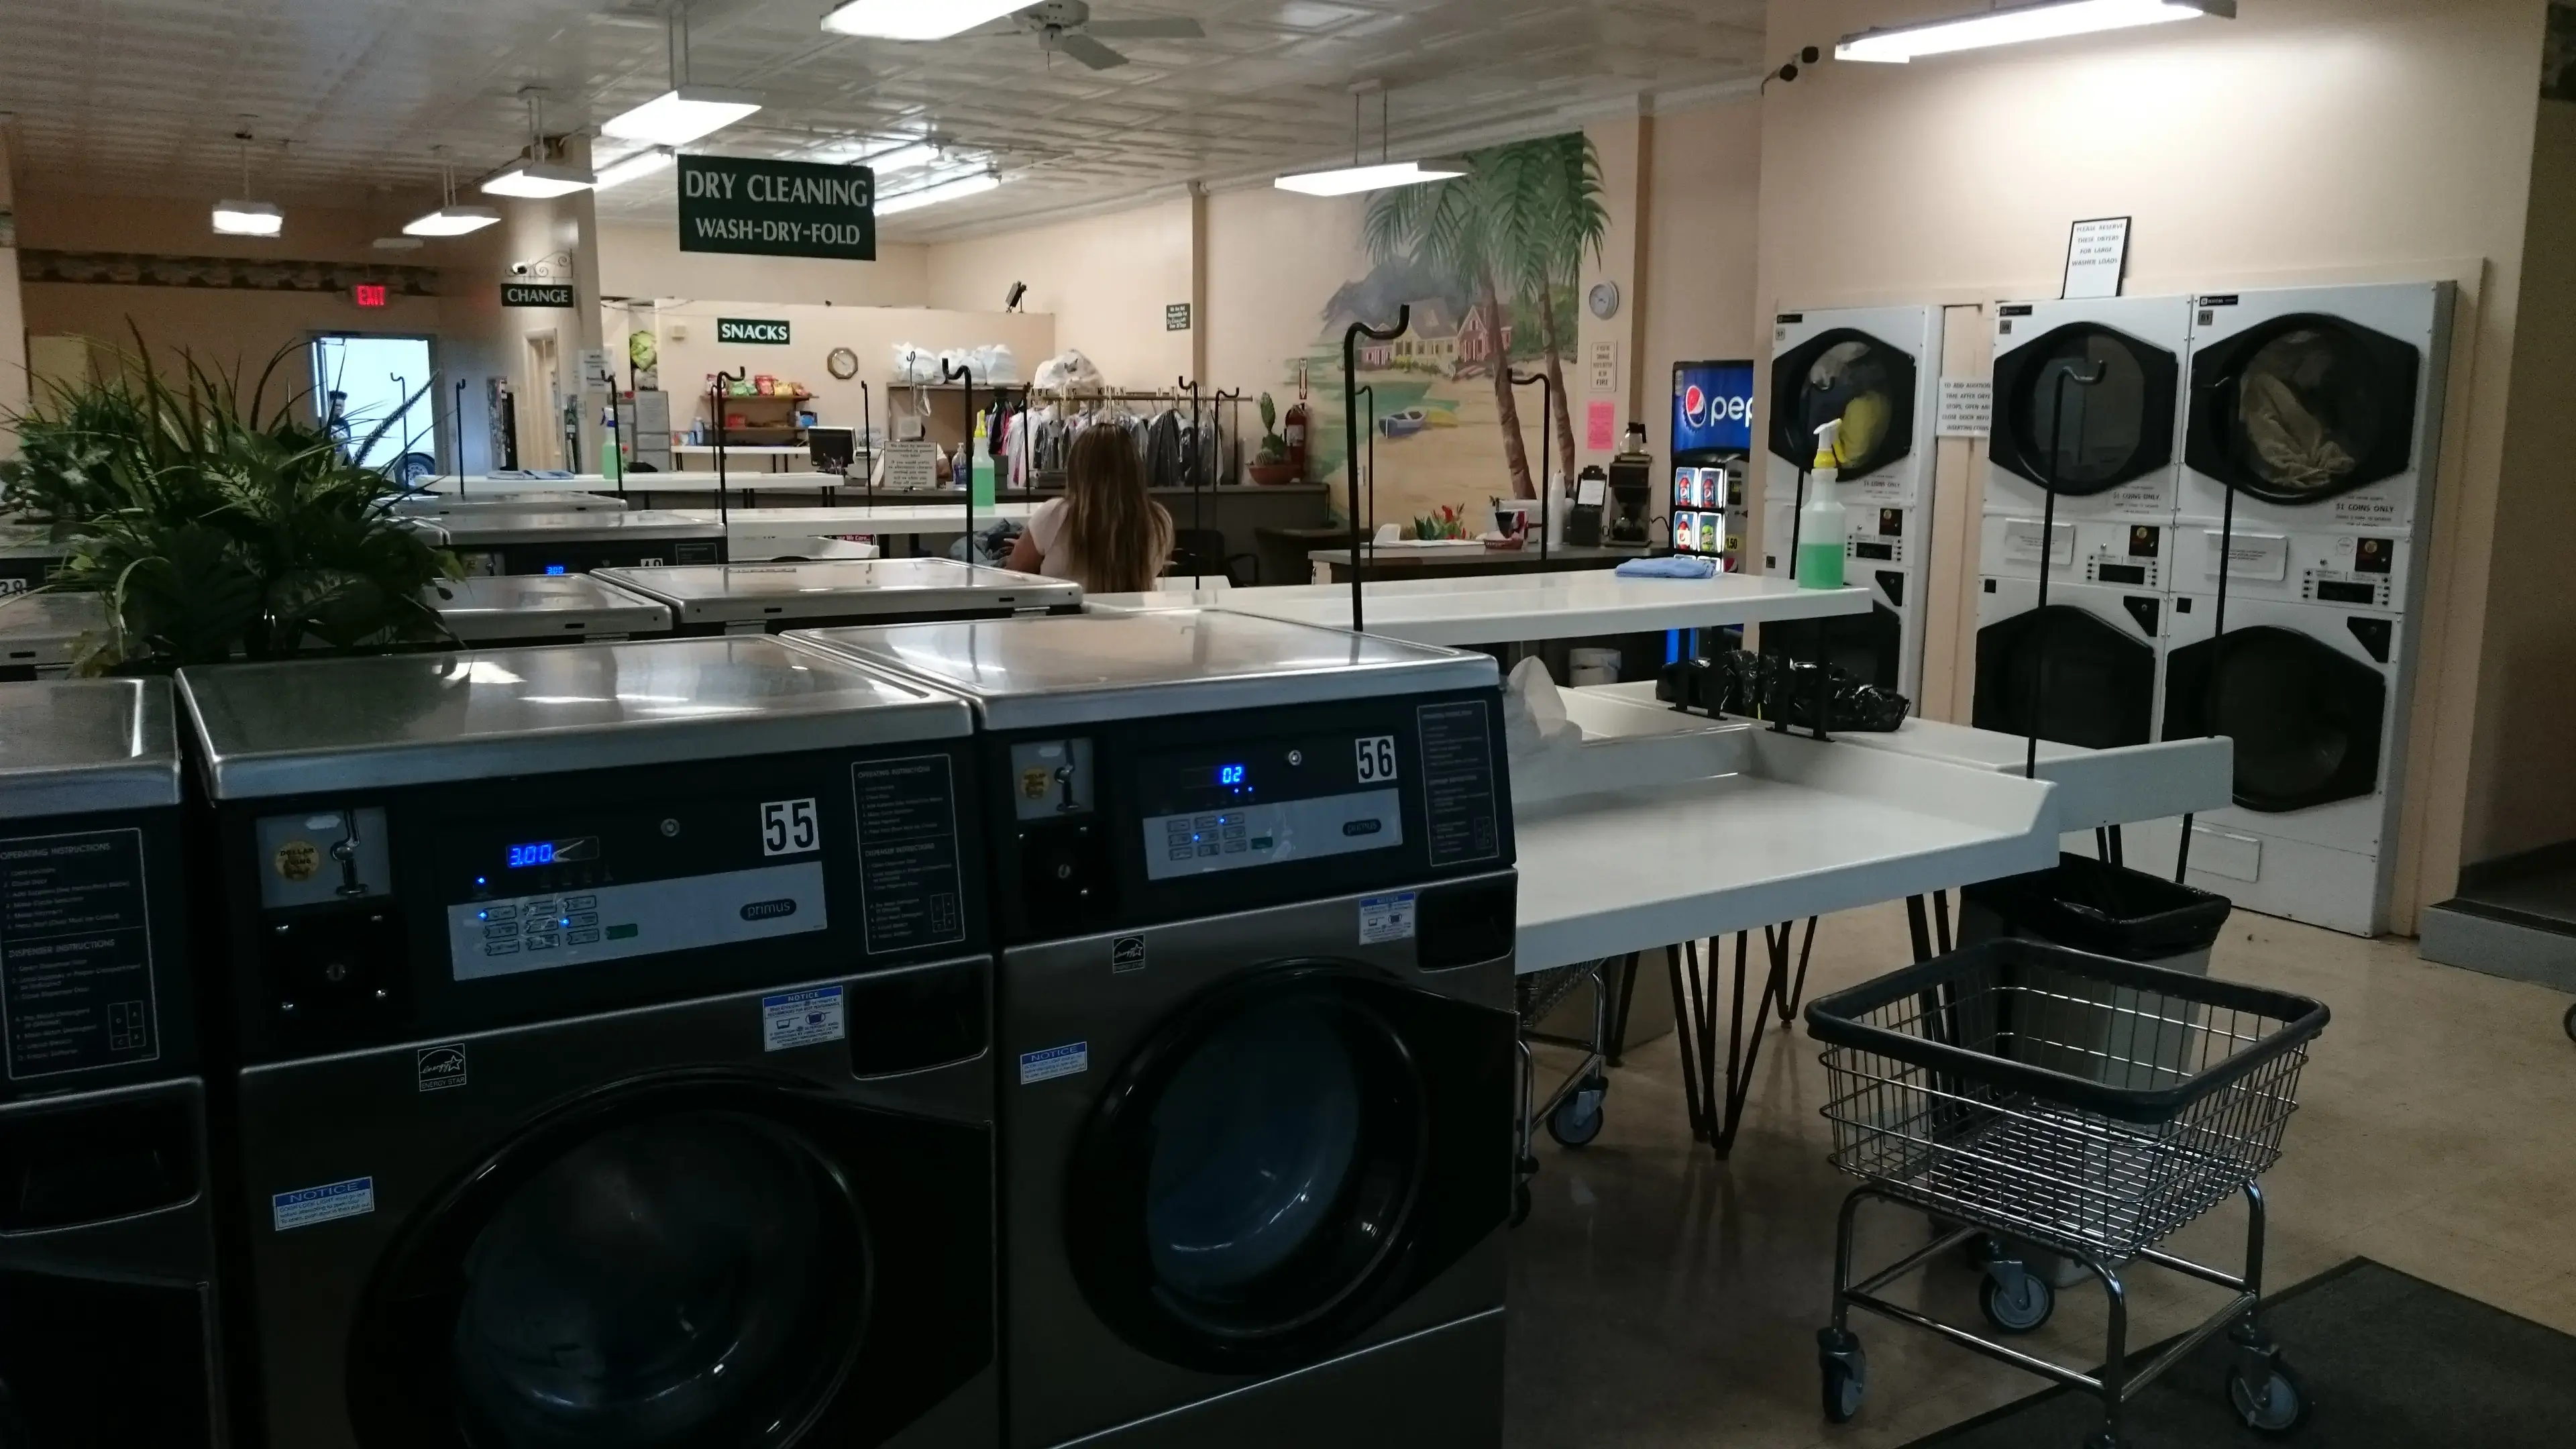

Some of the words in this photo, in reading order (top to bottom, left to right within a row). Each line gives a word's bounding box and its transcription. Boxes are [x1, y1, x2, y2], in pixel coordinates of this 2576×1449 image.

[685, 170, 737, 199] DRY
[747, 174, 867, 207] CLEANING
[695, 217, 861, 246] WASH-DRY-FOLD
[357, 286, 384, 305] EXIT
[507, 288, 568, 303] CHANGE
[721, 323, 788, 340] SNACKS
[2336, 502, 2345, 511] $1
[2348, 504, 2371, 512] COINS
[1358, 739, 1393, 779] 56
[1222, 765, 1243, 784] 02
[765, 802, 814, 851] 55
[0, 848, 50, 859] OPERATING
[51, 842, 111, 856] INSTRUCTIONS
[511, 844, 552, 867] 3.00
[747, 900, 790, 918] primus
[9, 946, 53, 958] DISPENSER
[56, 938, 115, 953] INSTRUCTIONS
[787, 991, 819, 1002] NOTICE
[1031, 1045, 1078, 1061] NOTICE
[421, 1079, 447, 1089] ENERGY
[447, 1075, 465, 1085] STAR
[289, 1182, 358, 1203] NOTICE
